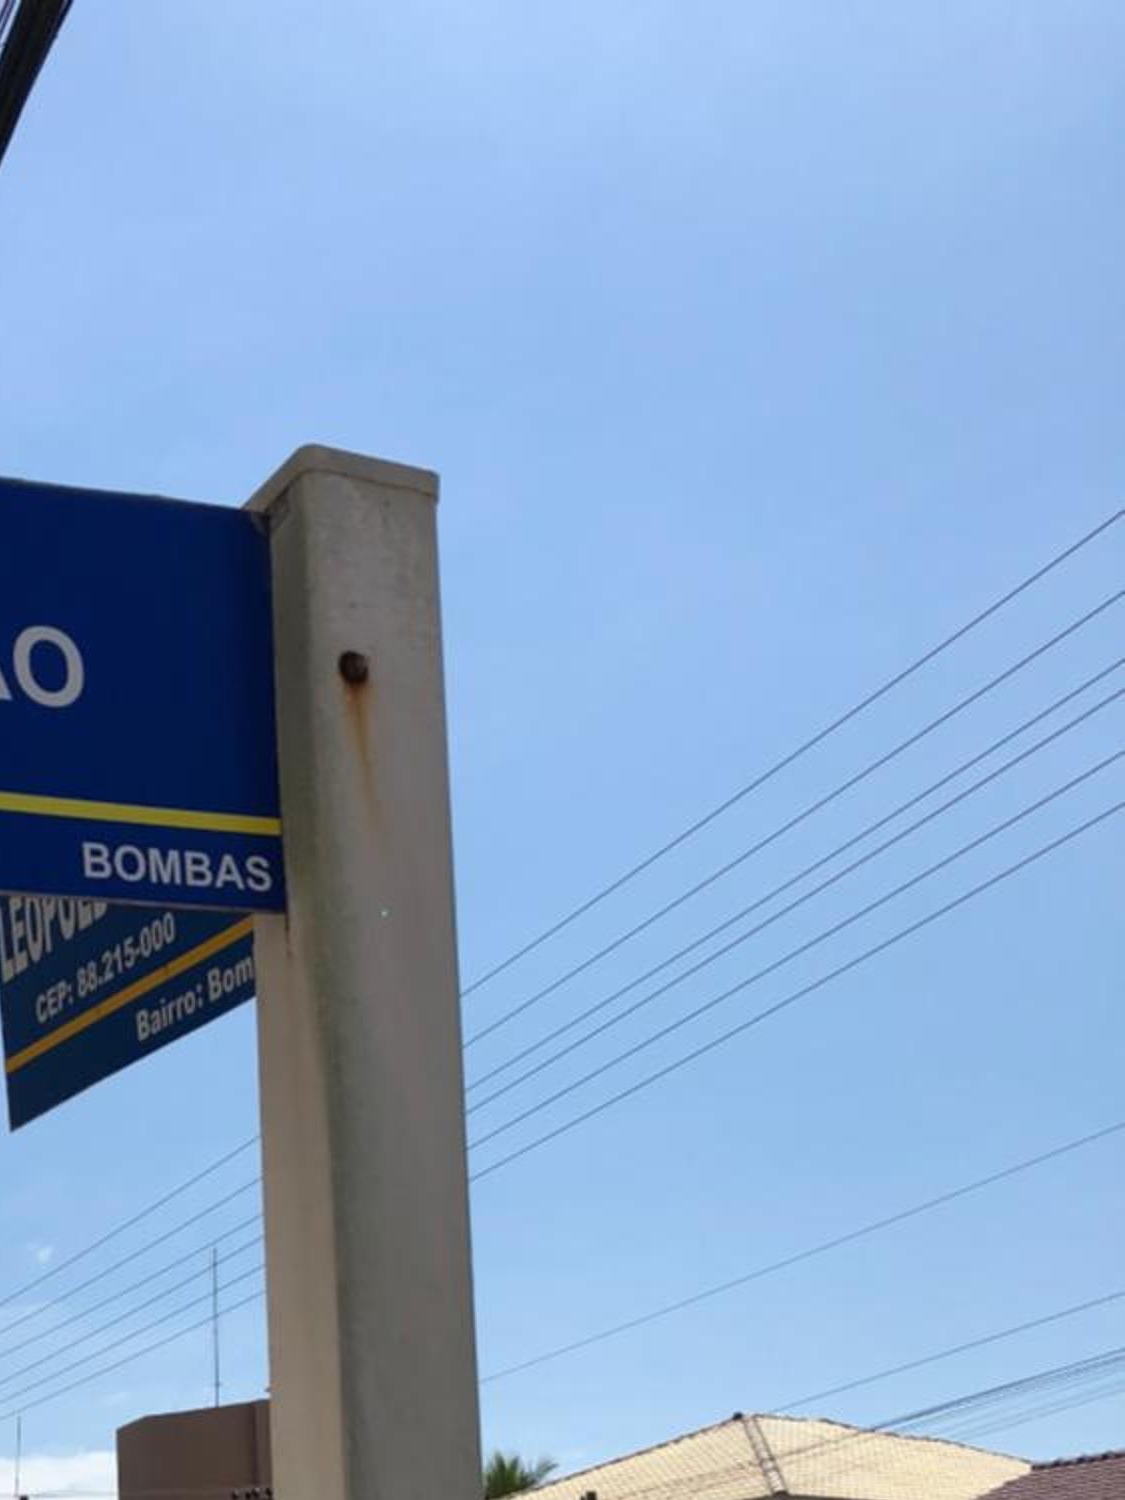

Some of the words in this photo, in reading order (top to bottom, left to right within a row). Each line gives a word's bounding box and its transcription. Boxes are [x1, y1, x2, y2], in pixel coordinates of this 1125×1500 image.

[82, 841, 273, 892] BOMBAS
[35, 979, 72, 1024] CEP:
[76, 911, 176, 999] 88.215-000
[135, 982, 204, 1042] Bairro:
